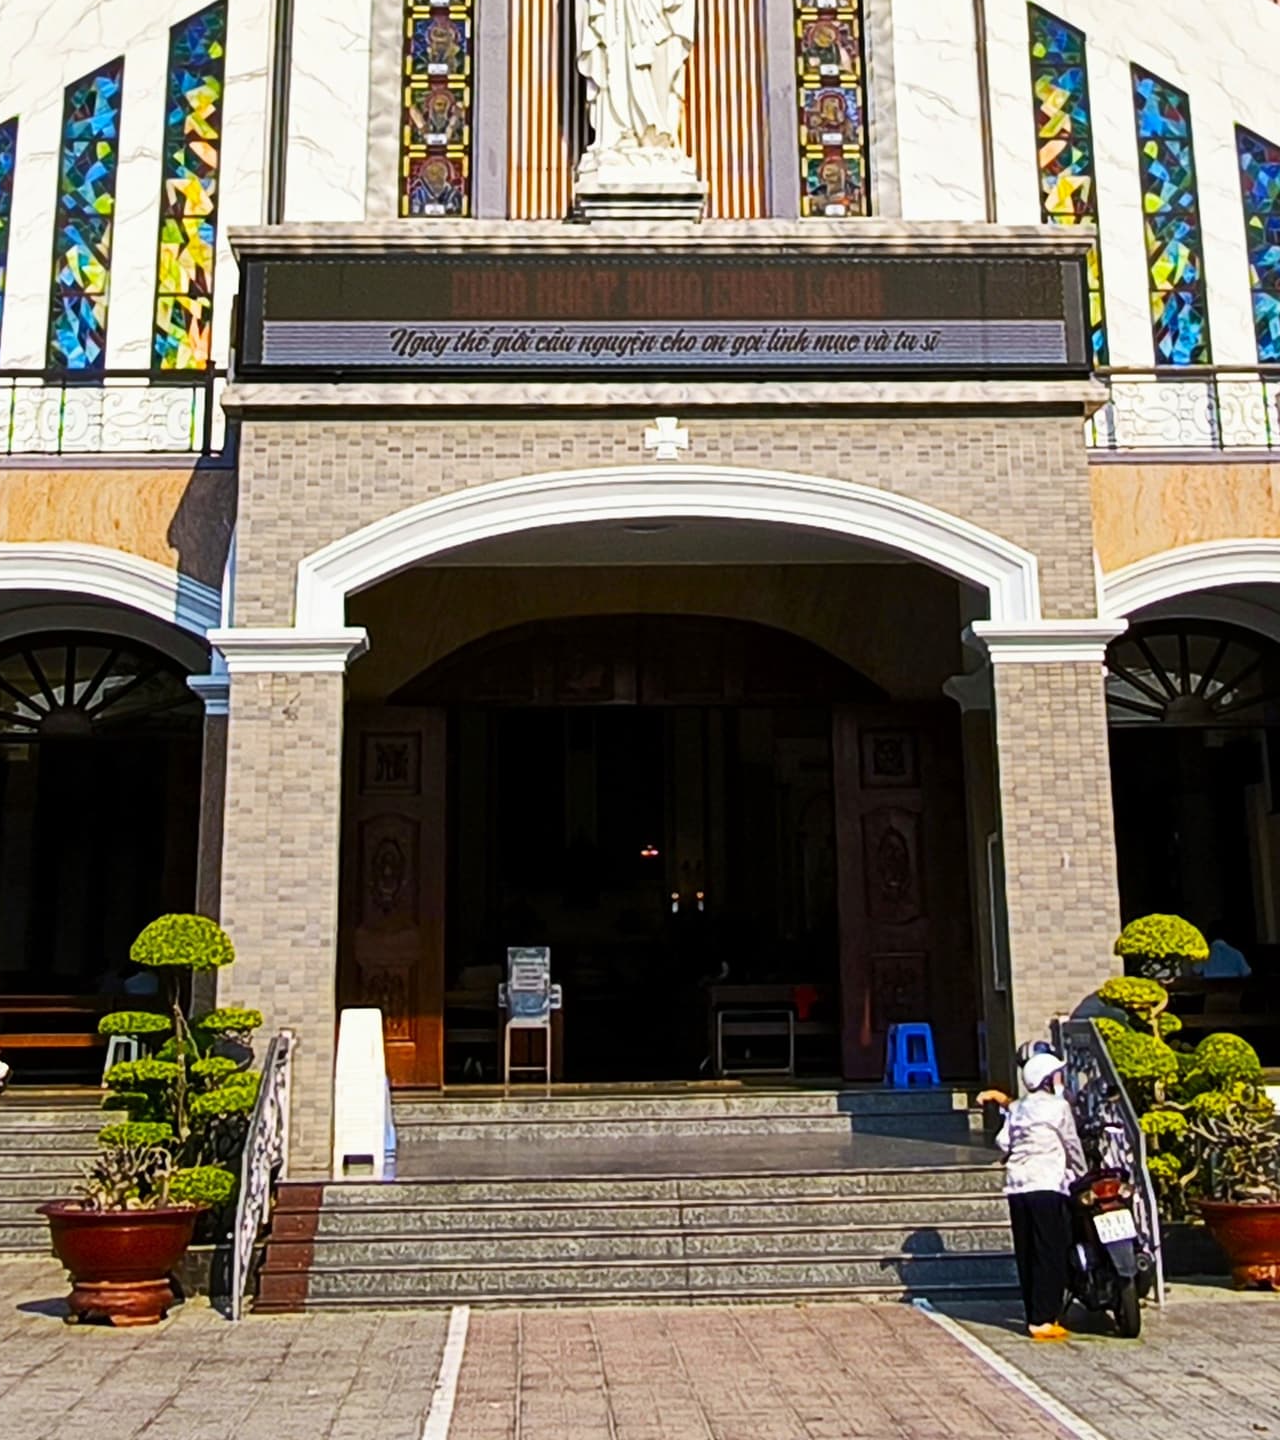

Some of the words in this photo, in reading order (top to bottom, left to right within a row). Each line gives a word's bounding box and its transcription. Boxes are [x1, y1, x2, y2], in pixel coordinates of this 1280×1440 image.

[390, 327, 452, 358] Ngày
[452, 326, 495, 352] thế
[577, 329, 657, 358] nguyện
[660, 327, 698, 352] cho
[766, 327, 811, 352] linh
[812, 333, 860, 354] mục
[864, 328, 892, 352] và
[893, 329, 919, 352] tu
